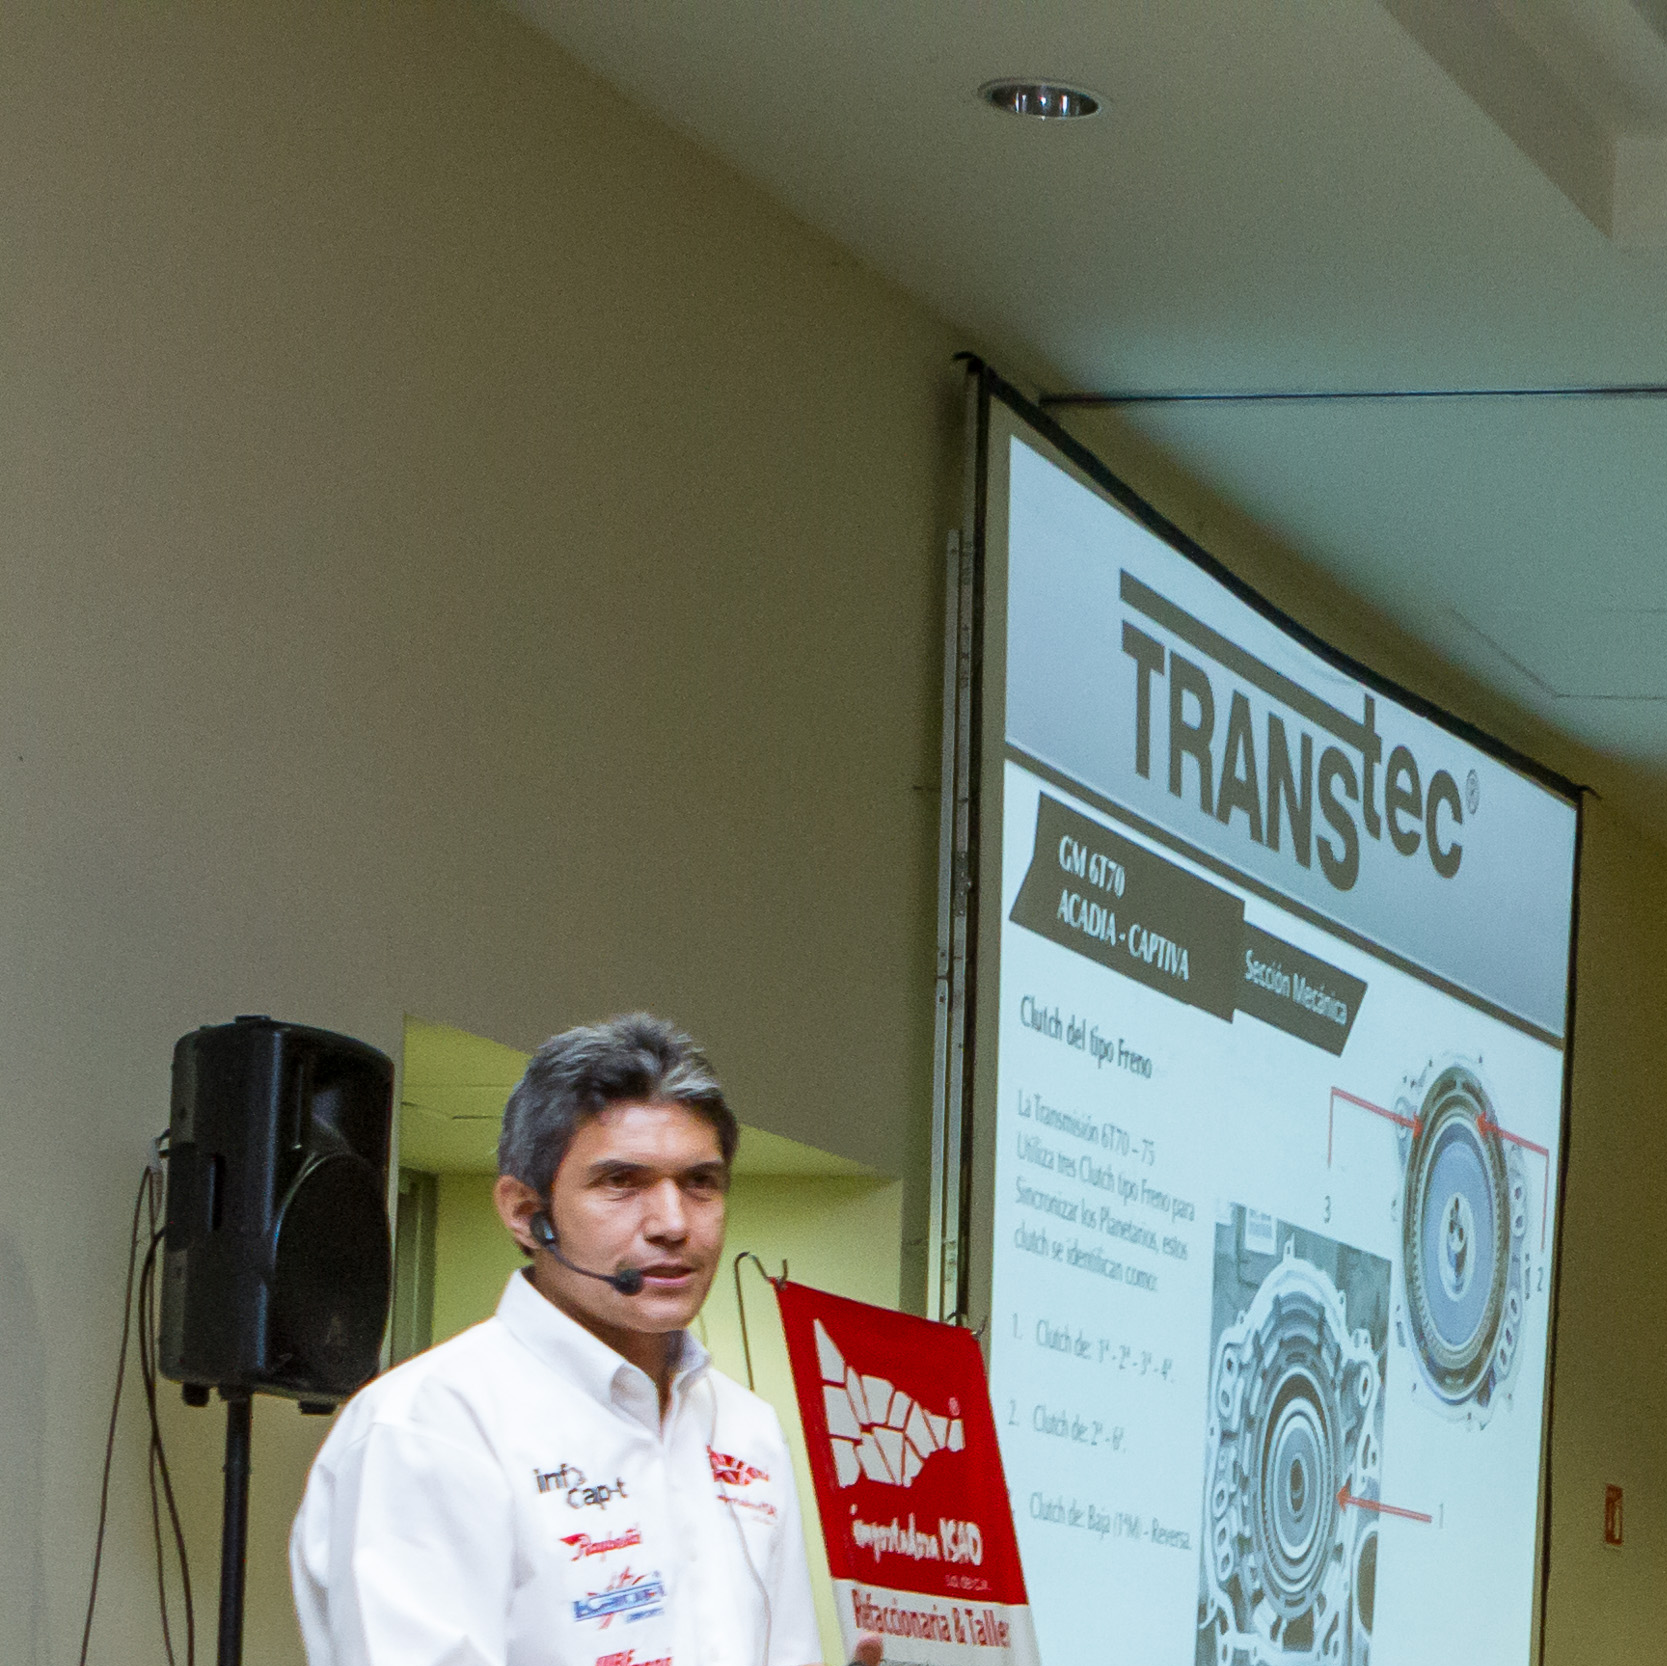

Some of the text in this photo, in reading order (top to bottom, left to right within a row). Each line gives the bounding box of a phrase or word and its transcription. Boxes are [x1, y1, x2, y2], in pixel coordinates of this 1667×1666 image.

[1059, 835, 1125, 900] GM 6T70
[1057, 889, 1116, 947] ACADIA
[1128, 923, 1189, 982] CAPTIVA
[1020, 994, 1153, 1079] Clutch del tipo Freno
[1017, 1088, 1032, 1118] La
